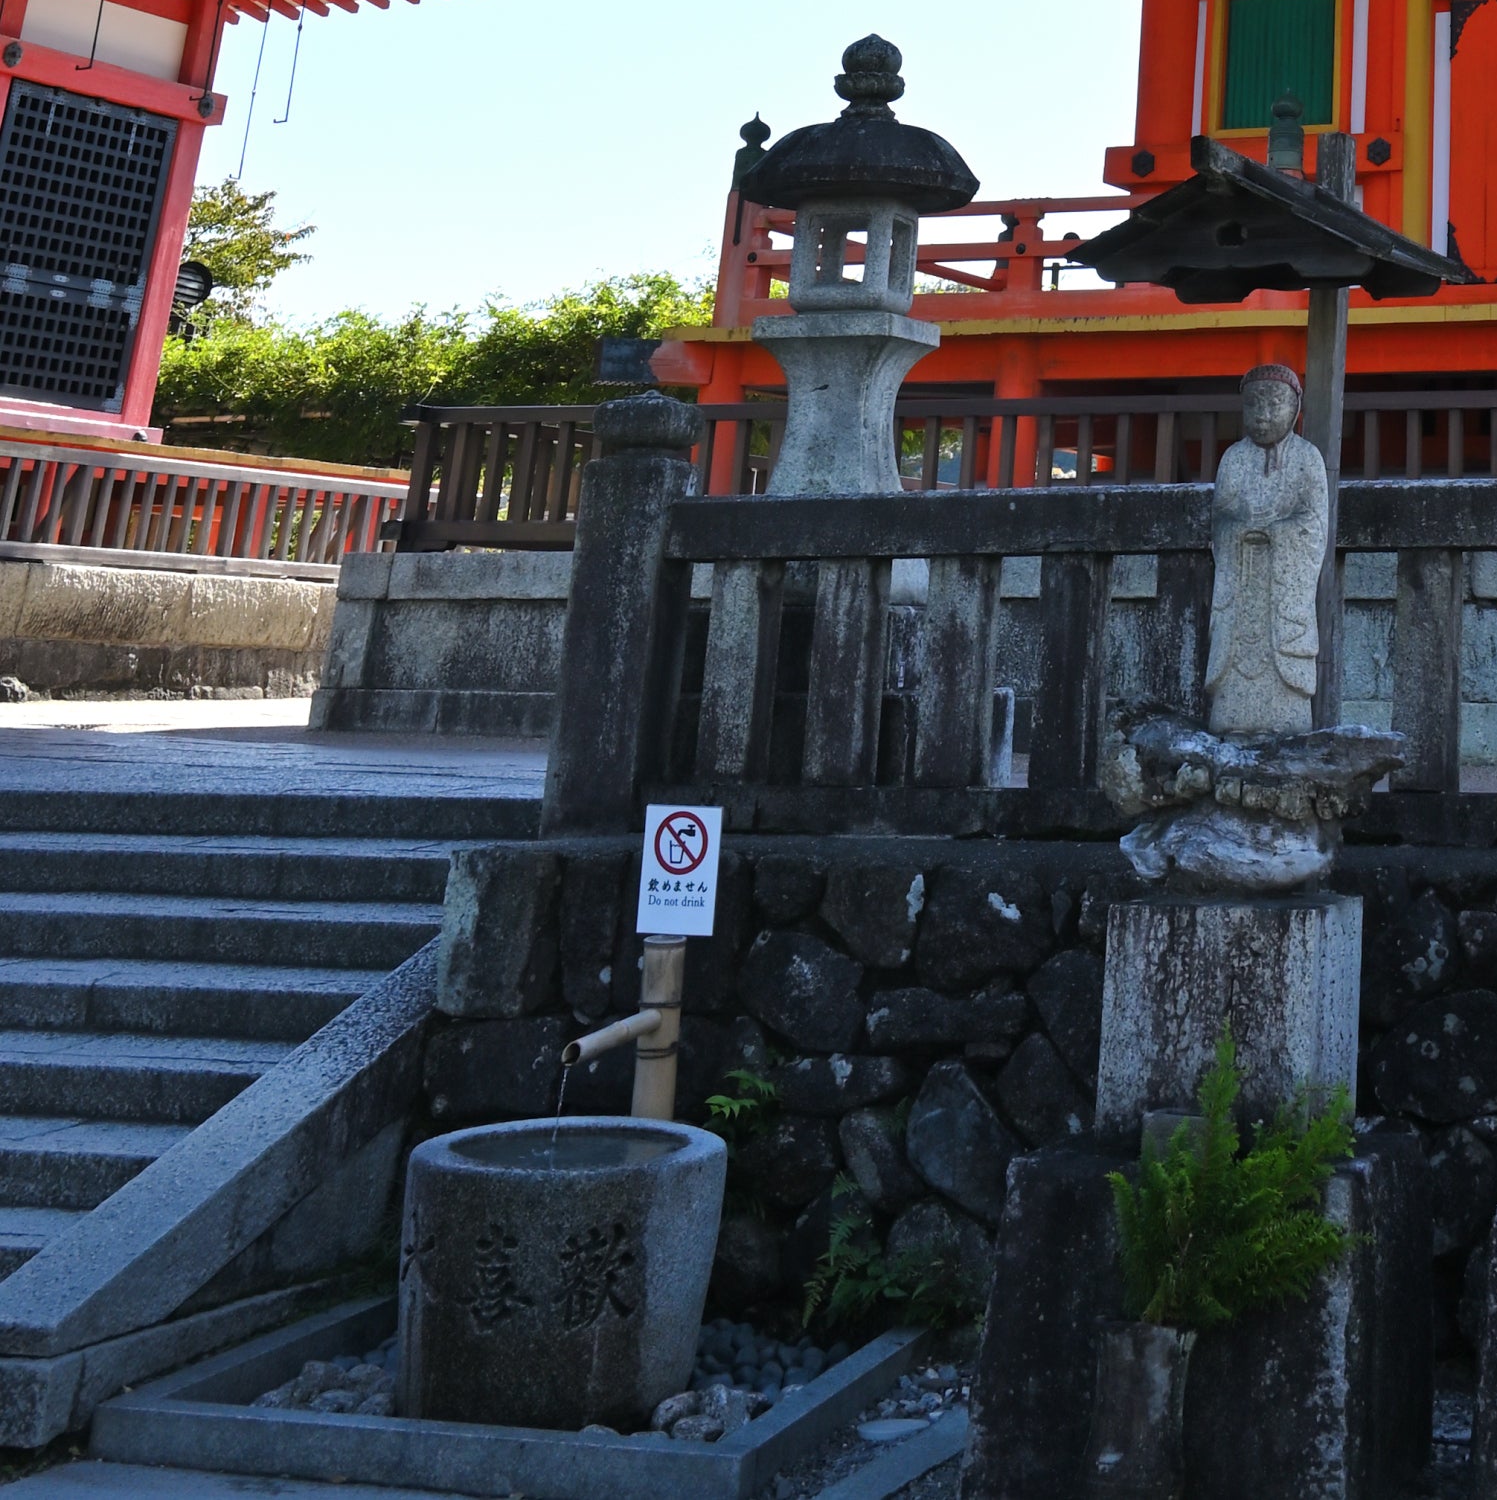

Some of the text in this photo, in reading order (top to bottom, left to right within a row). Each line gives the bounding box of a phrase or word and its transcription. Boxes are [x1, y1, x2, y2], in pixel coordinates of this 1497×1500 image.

[647, 878, 708, 893] 飲めません
[648, 895, 705, 908] Do not drink
